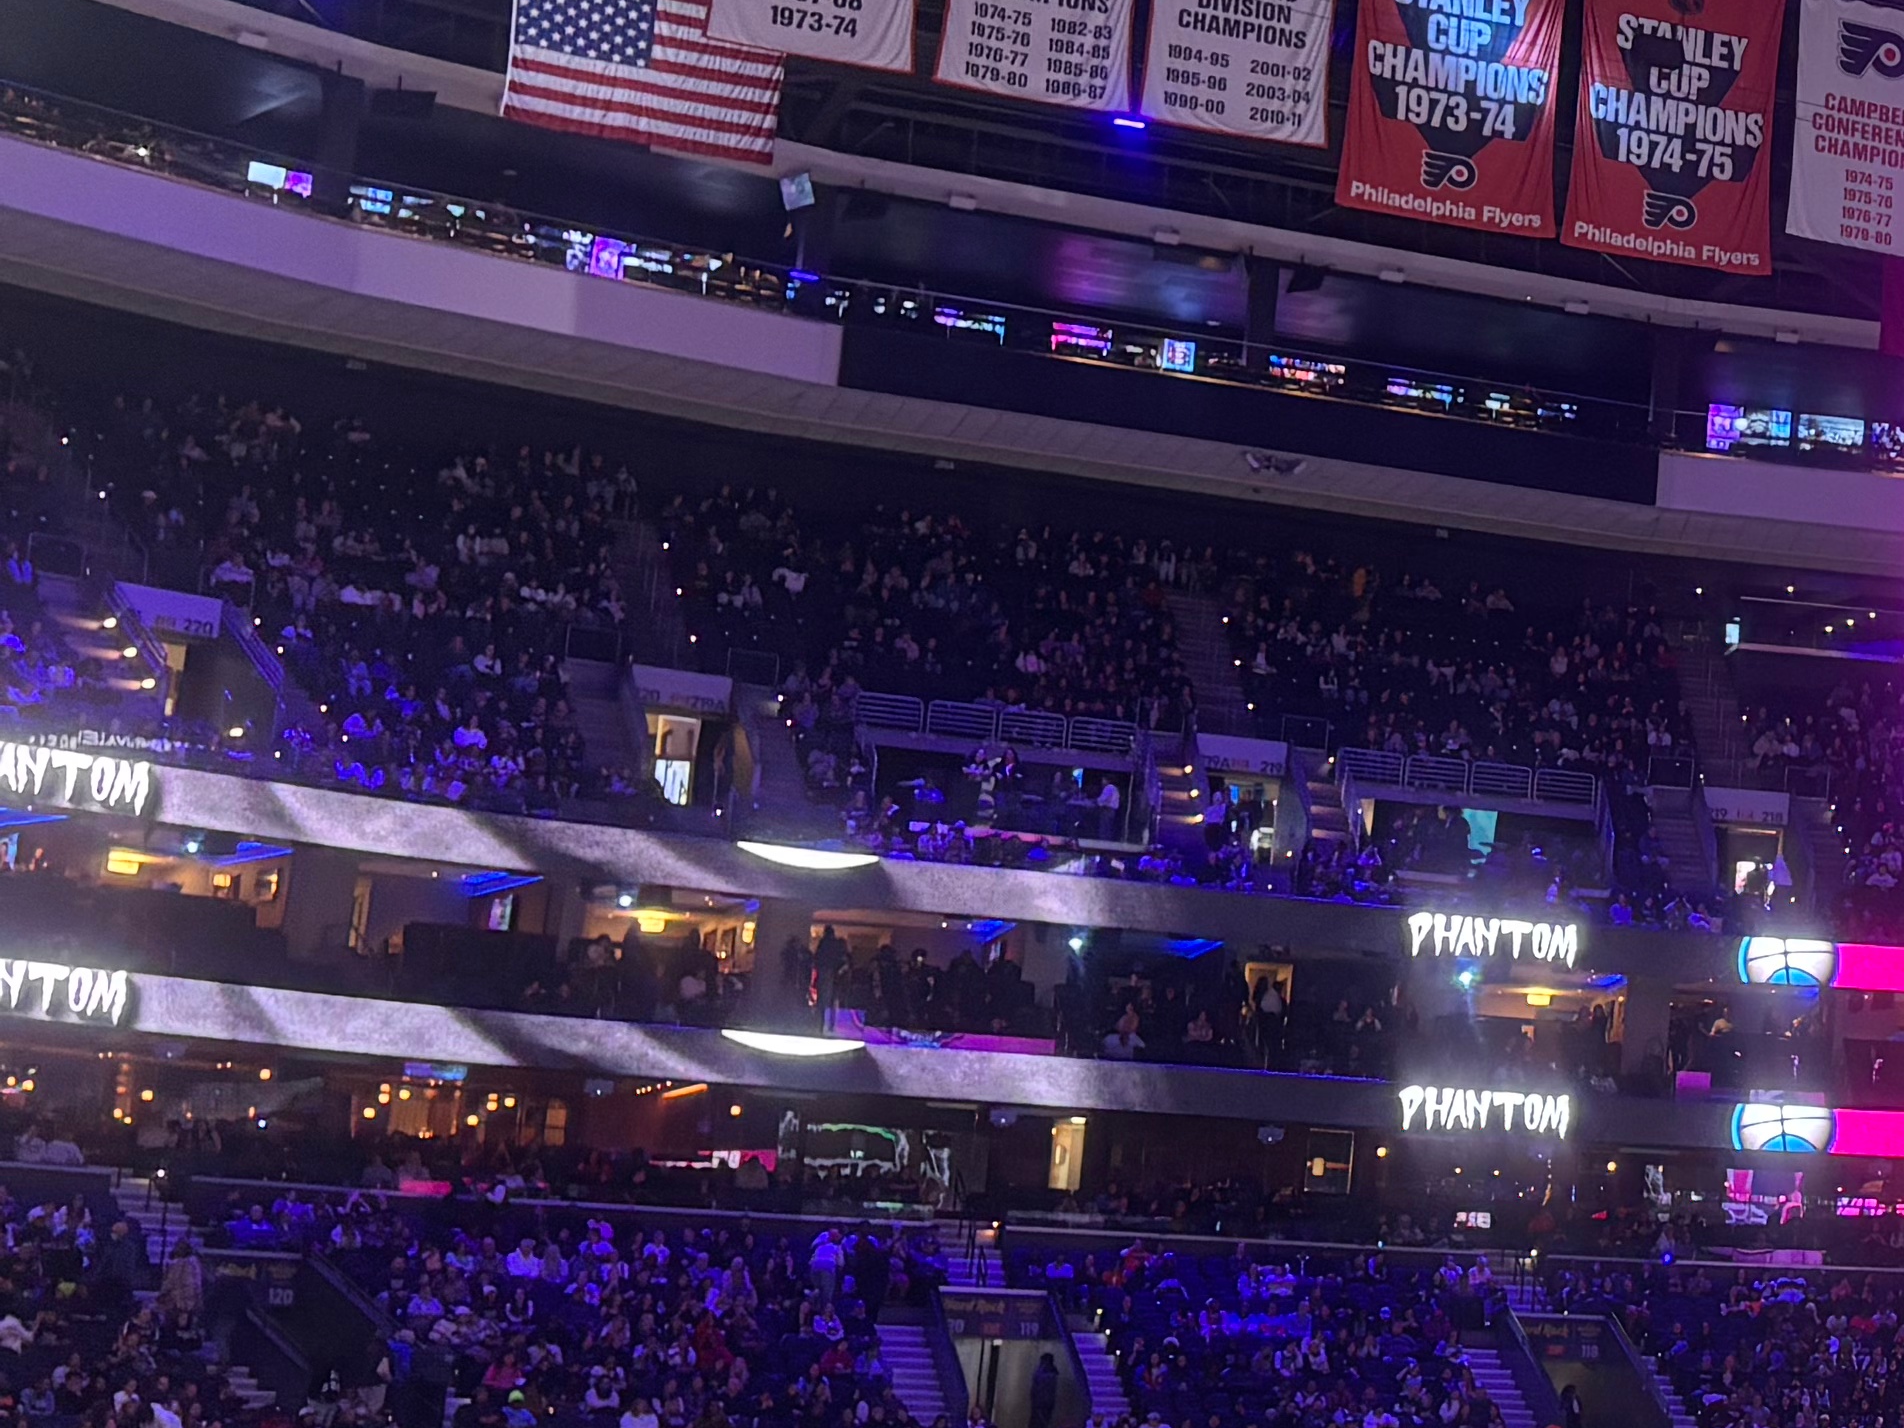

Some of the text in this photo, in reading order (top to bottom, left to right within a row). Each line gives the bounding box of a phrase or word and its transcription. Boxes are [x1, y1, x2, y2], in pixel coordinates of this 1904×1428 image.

[770, 4, 858, 38] 1973-74
[970, 21, 1111, 59] 1975-76 1984-85
[973, 0, 1112, 40] 1974-75 1982-83
[1177, 9, 1306, 50] CHAMPIONS
[1427, 12, 1491, 55] CUP
[967, 41, 1108, 81] 1976-77 1985-86
[1617, 14, 1748, 71] STANLEY
[1044, 77, 1107, 100] 1986-87
[1250, 59, 1311, 82] 2001-02
[1367, 40, 1549, 108] CHAMPIONS
[1649, 69, 1710, 100] CUP
[1245, 82, 1310, 105] 2003-04
[1395, 86, 1516, 140] 1973-74
[1249, 105, 1302, 128] 2010-11
[1589, 82, 1764, 150] CHAMPIONS
[1617, 128, 1733, 182] 1974-75
[1844, 169, 1894, 190] 1974-75
[1349, 180, 1542, 229] Philadelphia Flyers
[1842, 206, 1892, 227] 1976-77
[1574, 221, 1760, 267] Philadelphia Flyers
[1407, 911, 1577, 969] PHANTOM
[1399, 1085, 1570, 1142] PHANTOM
